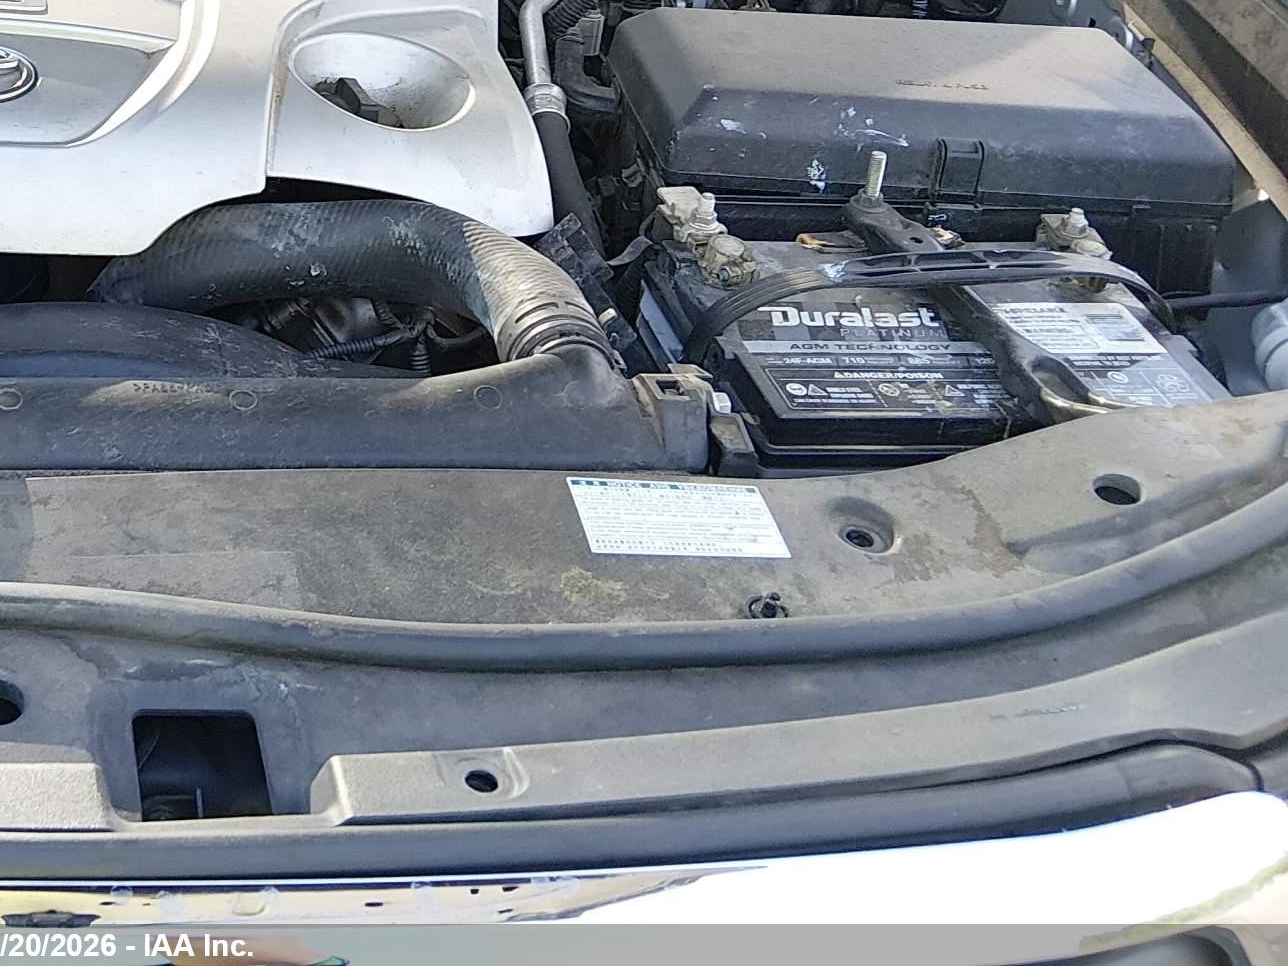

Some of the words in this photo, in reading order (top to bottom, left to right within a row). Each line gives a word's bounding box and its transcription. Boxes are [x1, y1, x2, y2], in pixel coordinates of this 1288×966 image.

[757, 306, 940, 328] Duralast
[840, 328, 945, 338] PLATINUM
[789, 343, 830, 351] AGM
[834, 343, 952, 352] TECHNOLOGY
